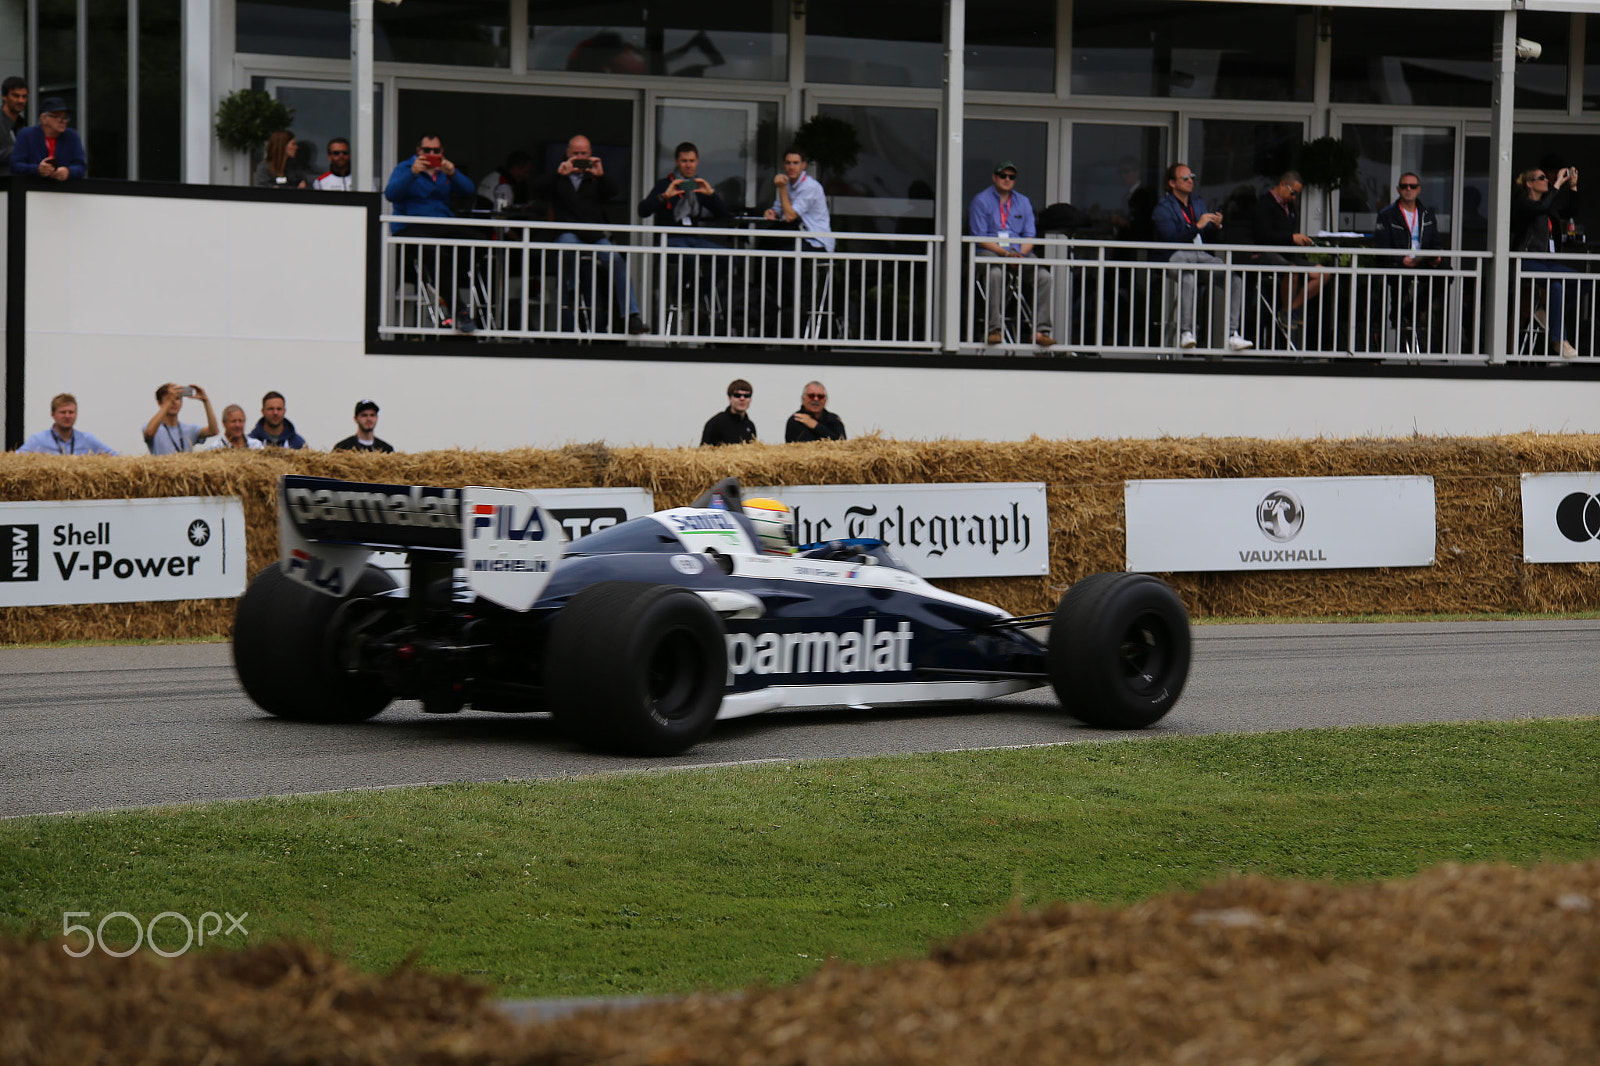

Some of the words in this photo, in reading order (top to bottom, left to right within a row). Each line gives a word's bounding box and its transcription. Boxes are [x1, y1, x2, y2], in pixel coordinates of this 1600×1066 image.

[286, 485, 462, 530] parmalat
[472, 505, 544, 541] FILA
[53, 522, 110, 546] Shell
[844, 502, 1031, 556] Telegraph
[12, 527, 29, 578] NEW
[53, 551, 200, 581] V-Power
[288, 549, 344, 594] FILA
[471, 560, 548, 572] MICHELIN
[1239, 549, 1327, 562] VAUXHALL
[725, 618, 914, 686] parmalat
